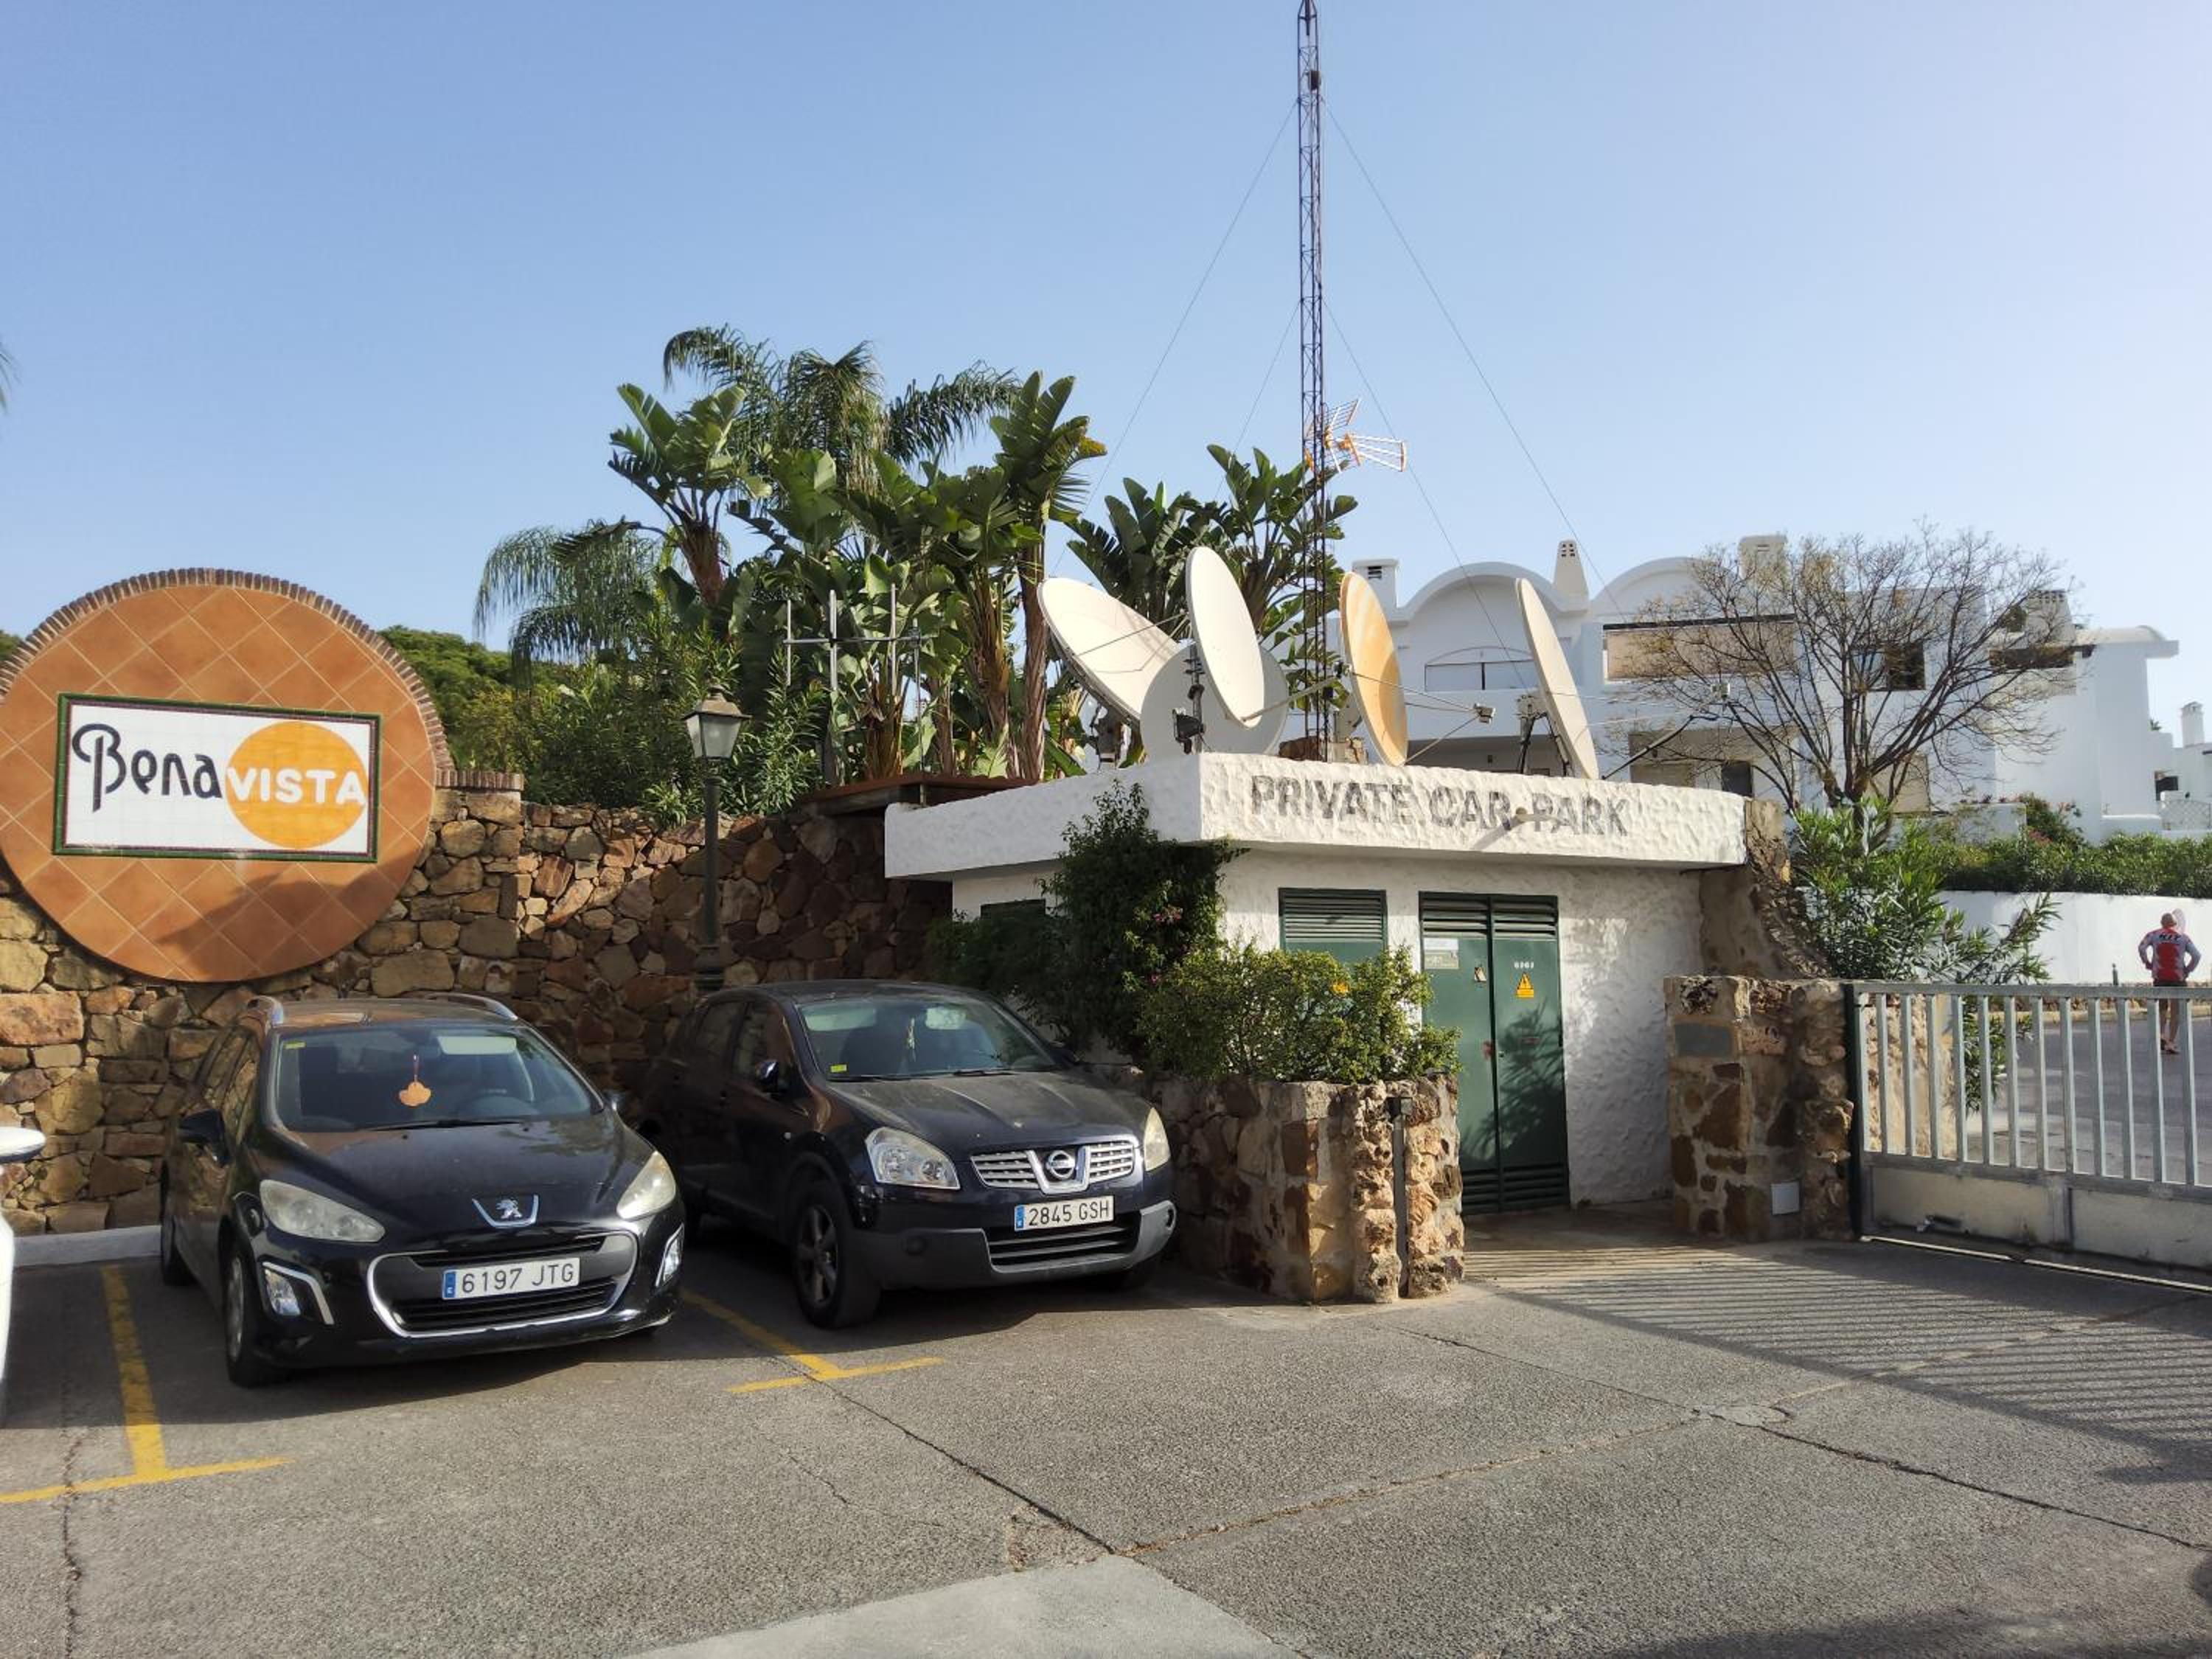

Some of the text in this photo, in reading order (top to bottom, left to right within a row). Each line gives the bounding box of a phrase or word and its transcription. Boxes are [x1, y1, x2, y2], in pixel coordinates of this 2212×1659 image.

[1252, 774, 1629, 837] PRIVATE CAR PARK
[1028, 1200, 1110, 1227] 2845 GSH
[462, 1263, 574, 1293] 6197 JTG
